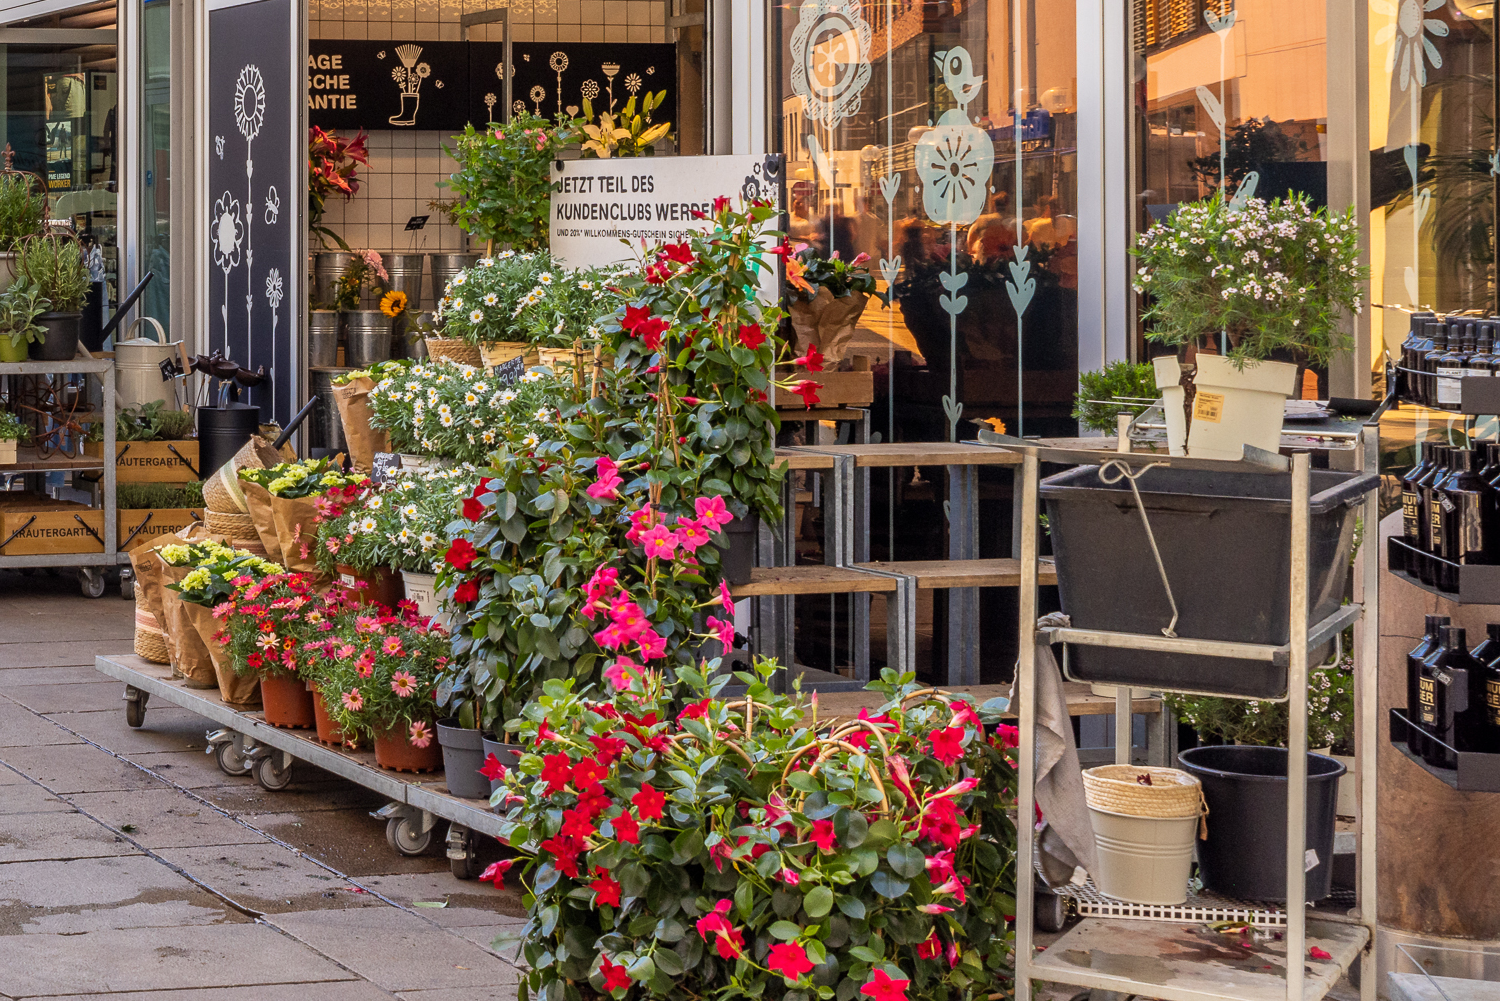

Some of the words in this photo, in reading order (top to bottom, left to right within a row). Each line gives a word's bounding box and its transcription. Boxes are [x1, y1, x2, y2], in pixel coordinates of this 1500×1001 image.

[557, 176, 594, 194] JETZT
[598, 176, 628, 194] TEIL
[632, 175, 654, 193] DES
[557, 203, 651, 221] KUNDENCLUBS
[557, 228, 569, 237] UND
[584, 229, 667, 239] WILLKOMMENS-GUTSCHEIN
[12, 527, 99, 539] KRÄUTERGARTEN
